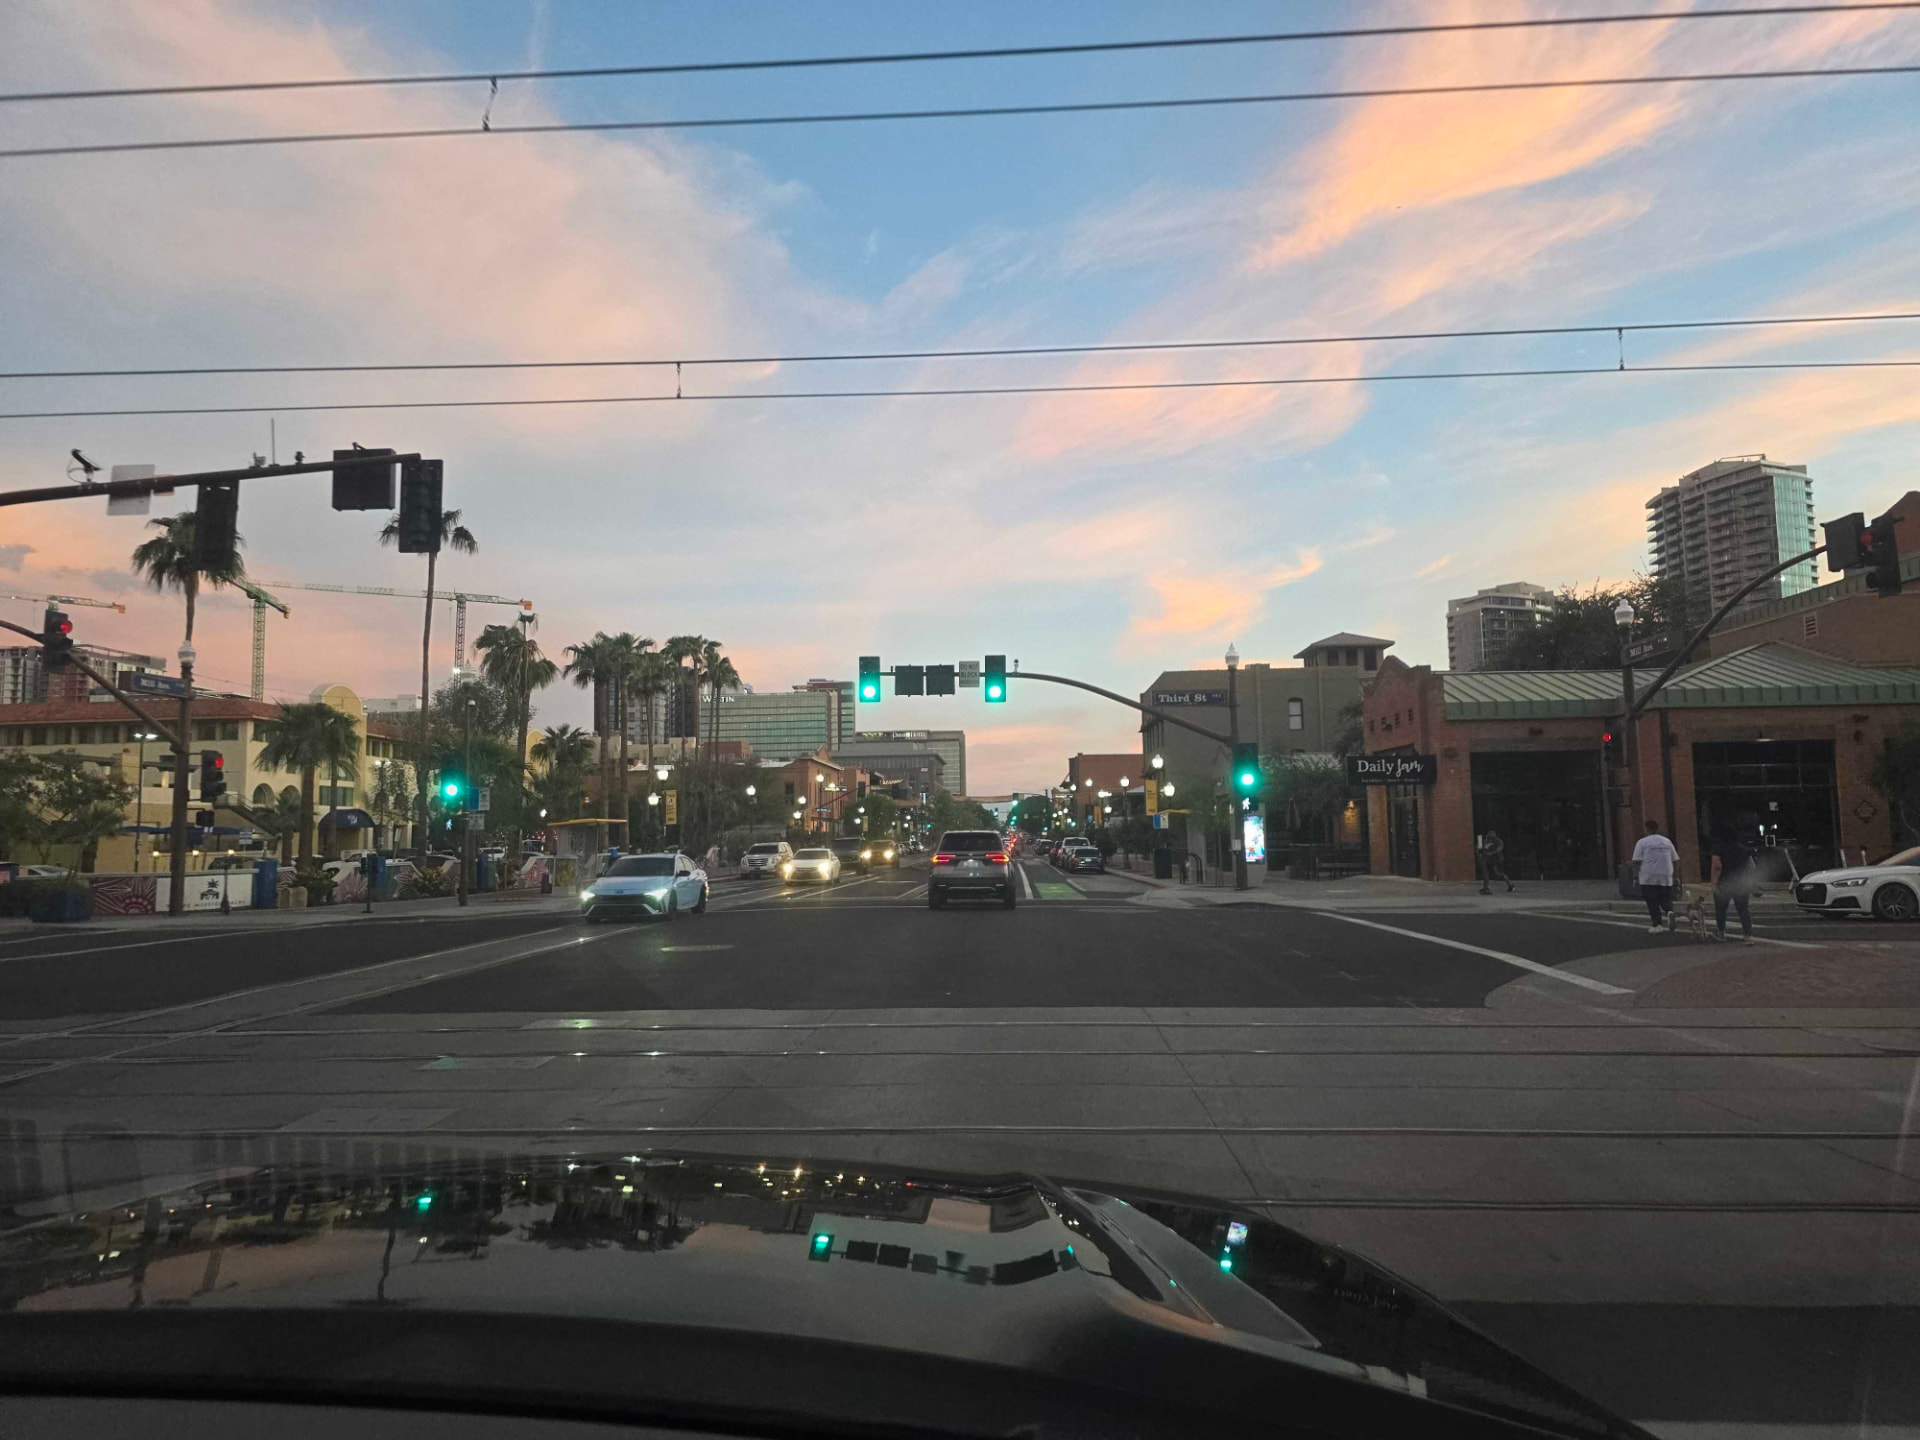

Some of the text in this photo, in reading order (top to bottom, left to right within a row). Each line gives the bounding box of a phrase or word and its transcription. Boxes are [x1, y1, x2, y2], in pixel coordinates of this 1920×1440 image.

[1158, 693, 1190, 703] Third
[1194, 693, 1207, 703] St
[1357, 758, 1424, 778] Daily Jam
